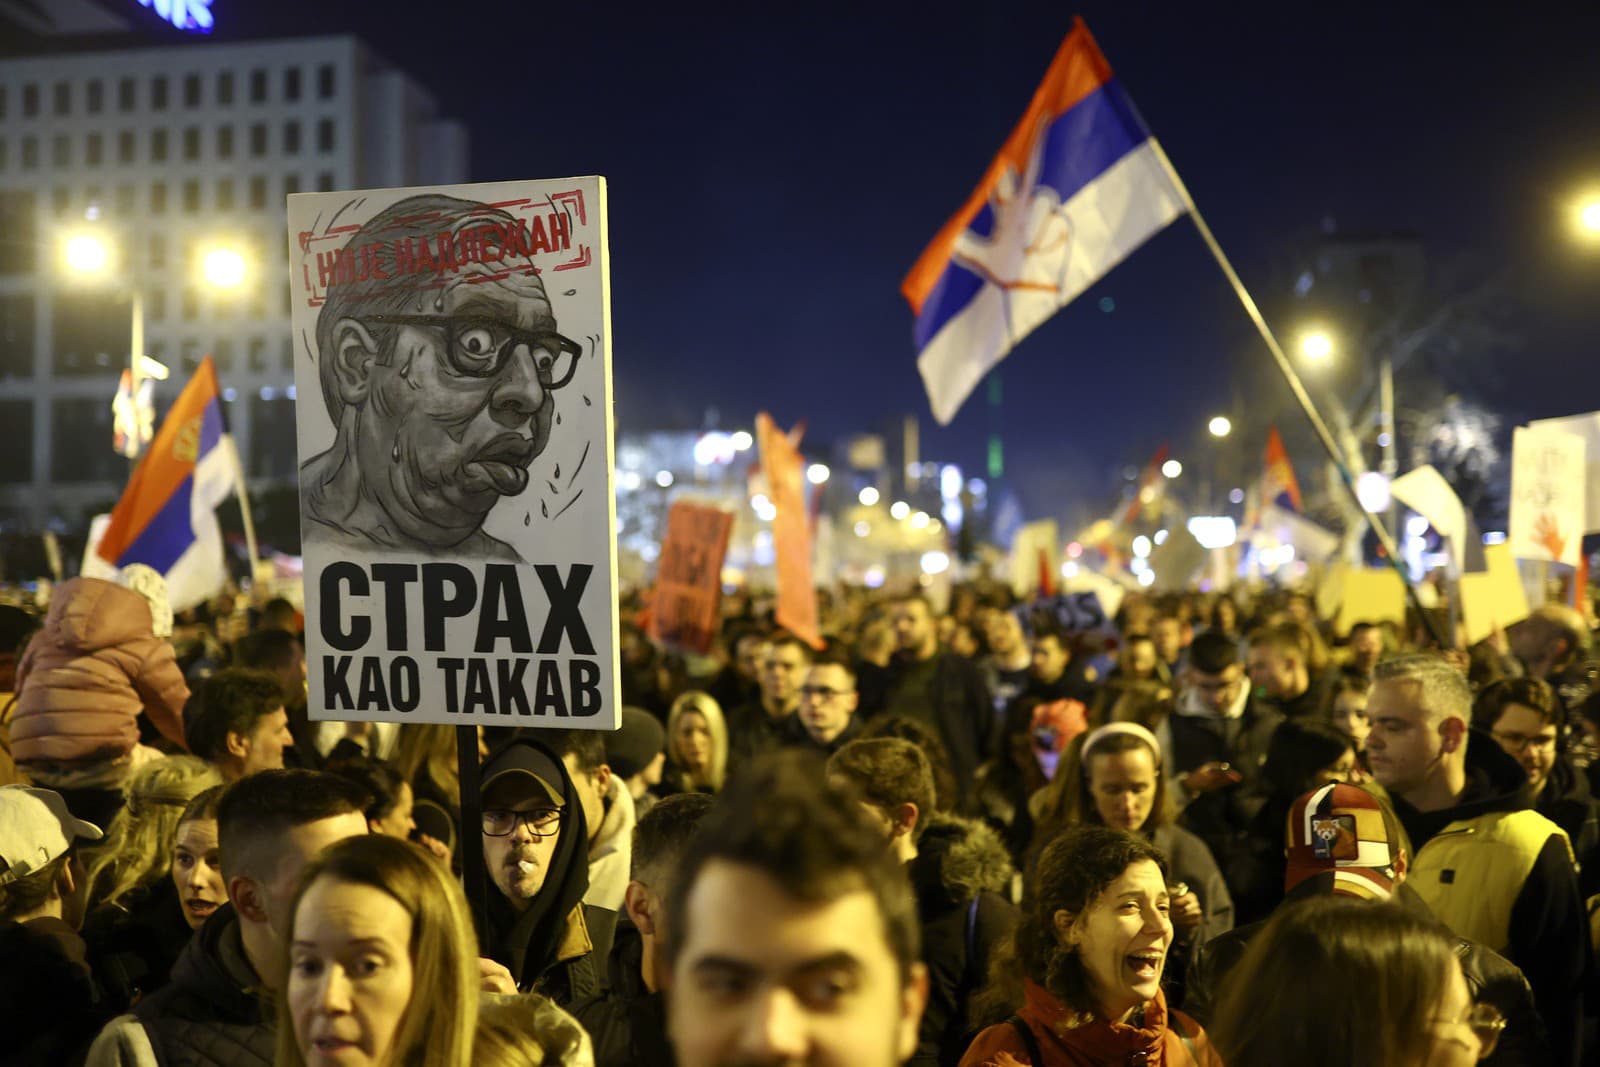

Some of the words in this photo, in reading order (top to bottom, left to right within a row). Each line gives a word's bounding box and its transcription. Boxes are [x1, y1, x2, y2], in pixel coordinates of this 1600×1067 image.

[317, 243, 388, 288] НИЈЕ
[396, 212, 571, 276] НАДЛЕЖАН
[319, 561, 598, 655] СТРАХ
[322, 655, 421, 713] КАО
[437, 657, 602, 717] ТАКАВ
